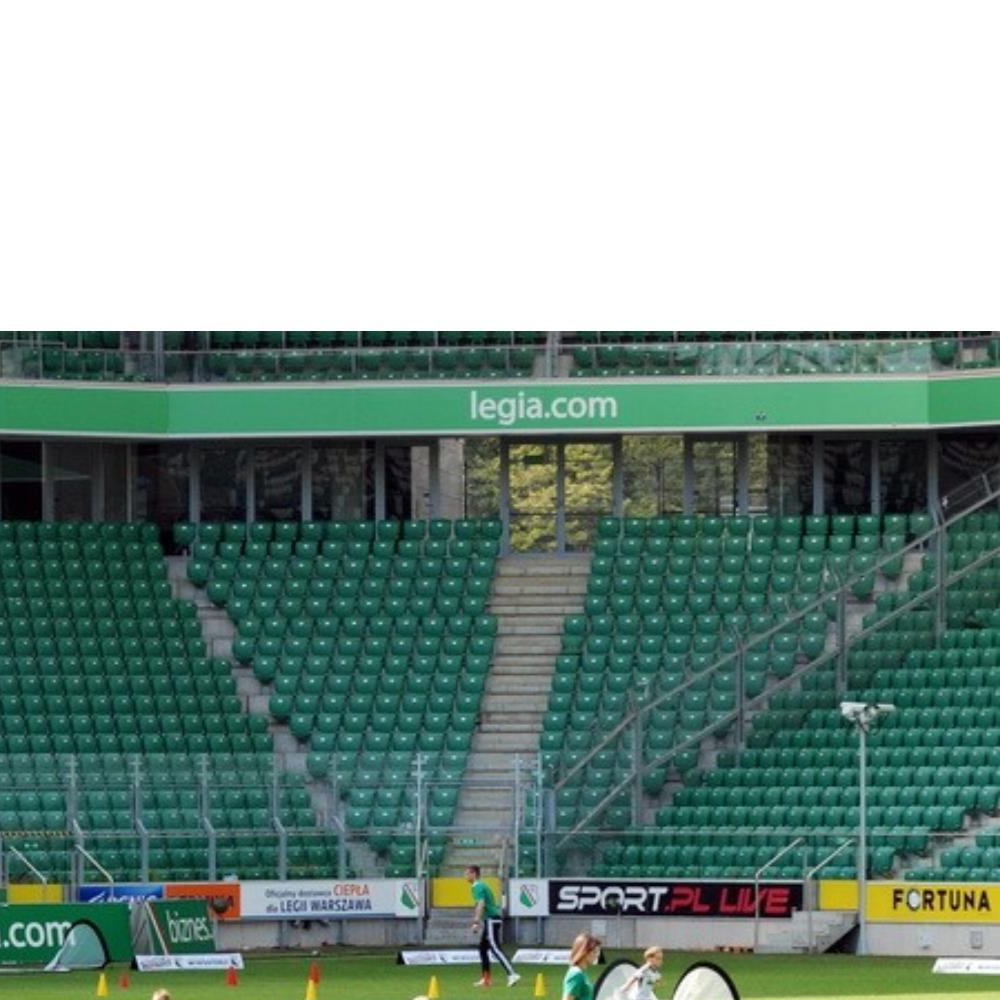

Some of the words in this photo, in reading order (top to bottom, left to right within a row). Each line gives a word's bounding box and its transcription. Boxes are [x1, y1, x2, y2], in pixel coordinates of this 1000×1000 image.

[470, 390, 618, 425] legia.com
[280, 899, 307, 912] LEGII
[311, 899, 372, 911] WARSZAWA
[719, 888, 790, 914] LIVE
[893, 888, 991, 911] FORTUNA
